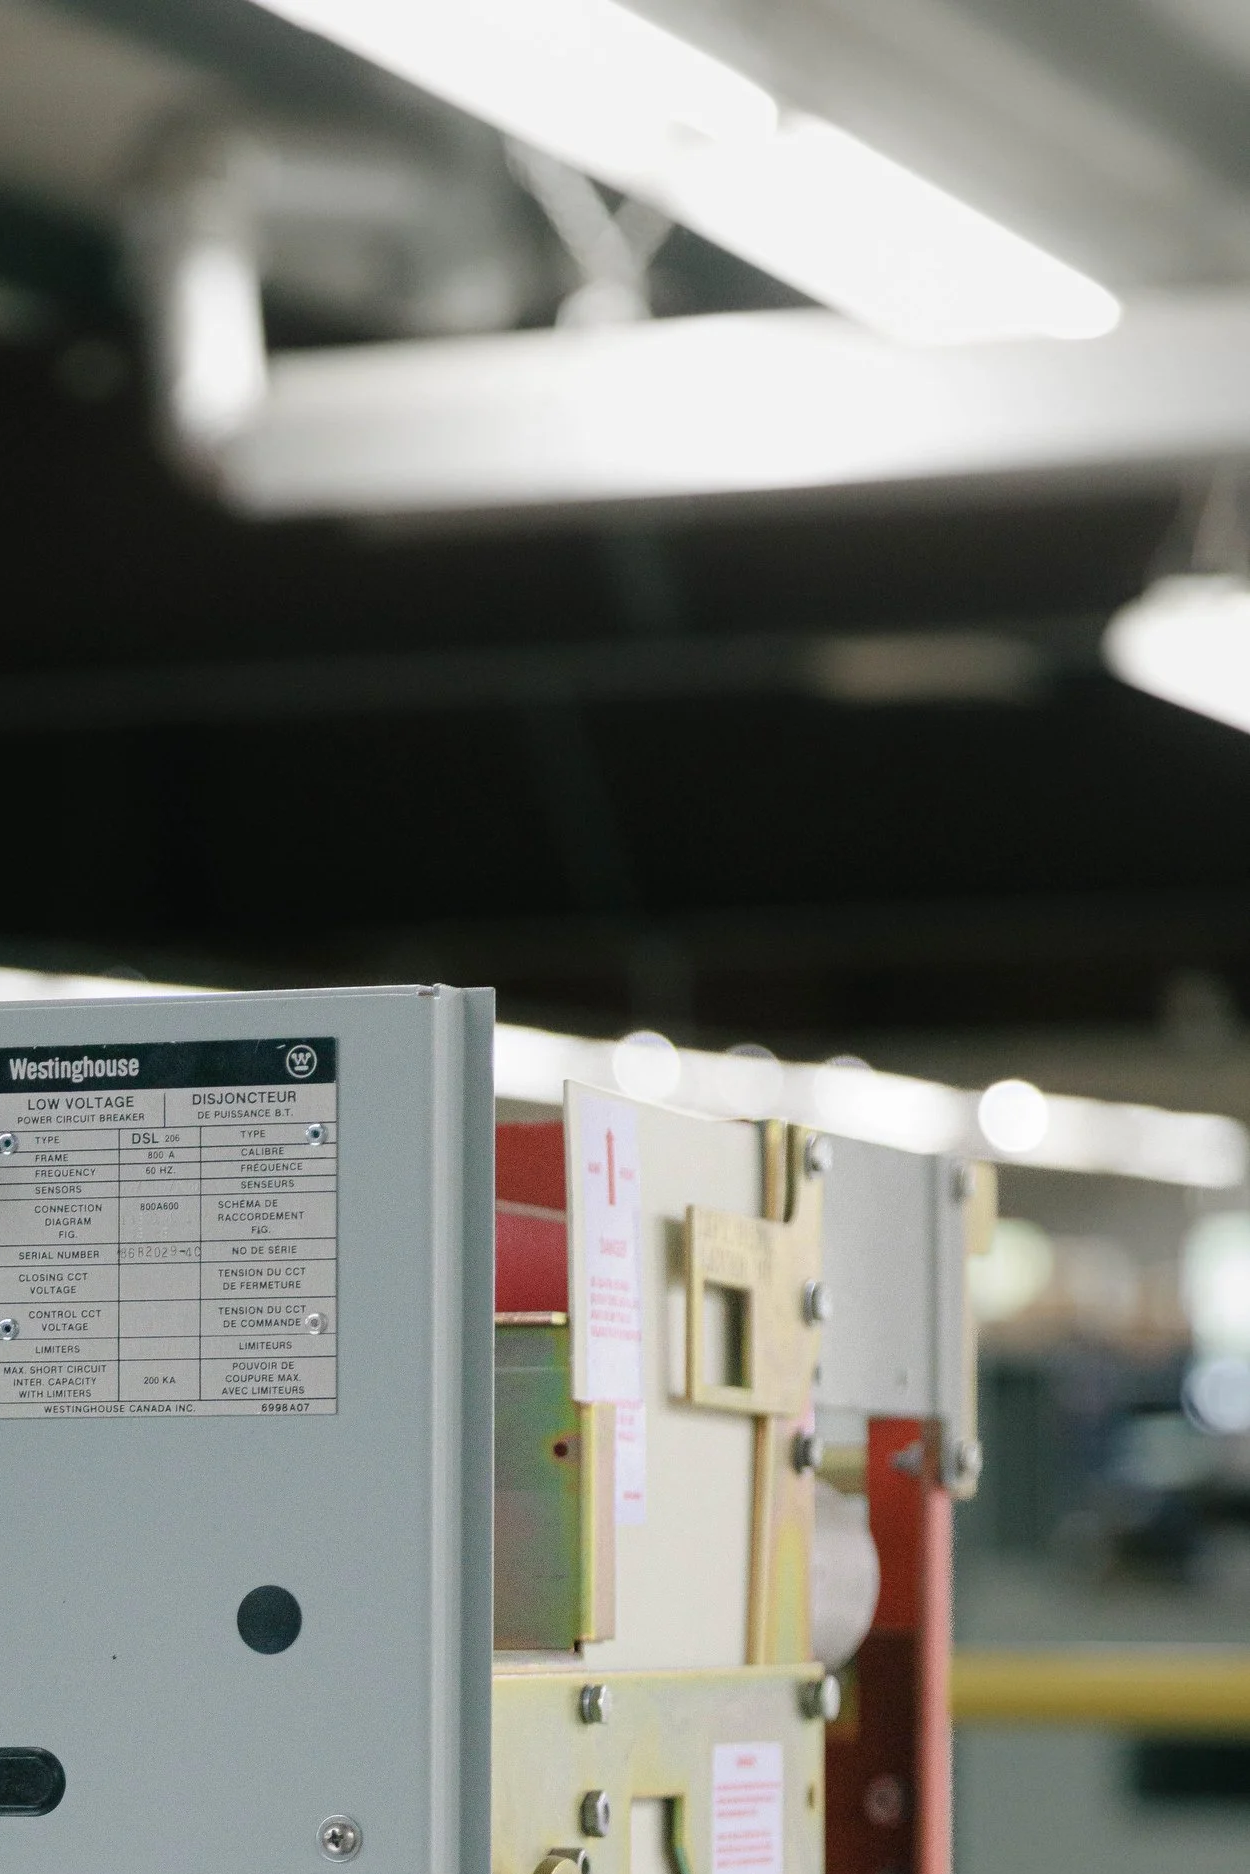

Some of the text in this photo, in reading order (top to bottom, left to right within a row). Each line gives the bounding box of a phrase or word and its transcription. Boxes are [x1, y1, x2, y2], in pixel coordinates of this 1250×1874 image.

[9, 1056, 139, 1083] Westinghouse
[193, 1091, 296, 1105] DISJONCTEUR
[28, 1096, 134, 1110] LOW VOLTAGE
[17, 1113, 145, 1124] POWER CIRCUIT BREAKER
[198, 1111, 210, 1119] DE
[214, 1109, 270, 1118] PUISSANCE
[132, 1133, 159, 1144] DSL
[241, 1130, 266, 1138] TYPE
[148, 1151, 163, 1159] 800
[241, 1148, 284, 1156] CALIBRE
[35, 1154, 69, 1162] FRAME
[35, 1169, 96, 1177] FREQUENCY
[160, 1166, 175, 1174] HZ.
[241, 1180, 294, 1189] SENSEURS
[35, 1186, 82, 1194] SENSORS
[35, 1204, 102, 1213] CONNECTION
[141, 1202, 179, 1210] 800A600
[218, 1212, 305, 1221] RACCORDEMENT
[45, 1218, 91, 1226] DIAGRAM
[252, 1226, 270, 1234] FIG.
[19, 1251, 100, 1260] SERIAL NUMBER
[232, 1247, 247, 1255] NO
[219, 1267, 305, 1277] TENSION DU CCT
[19, 1273, 88, 1282] CLOSING CCT
[30, 1286, 76, 1294] VOLTAGE
[223, 1281, 301, 1290] DE FERMETURE
[29, 1310, 101, 1319] CONTROL CCT
[218, 1306, 262, 1315] TENSION
[42, 1323, 89, 1331] VOLTAGE
[224, 1318, 301, 1328] DE COMMANDE
[35, 1345, 80, 1353] LIMITERS
[239, 1342, 292, 1350] LIMITEURS
[30, 1366, 63, 1374] SHORT
[67, 1365, 107, 1373] CIRCUIT
[232, 1362, 277, 1370] POUVOIR
[226, 1374, 273, 1382] COUPURE
[222, 1386, 304, 1395] AVEC LIMITEURS
[44, 1404, 195, 1413] WESTINGHOUSE CANADA INC.
